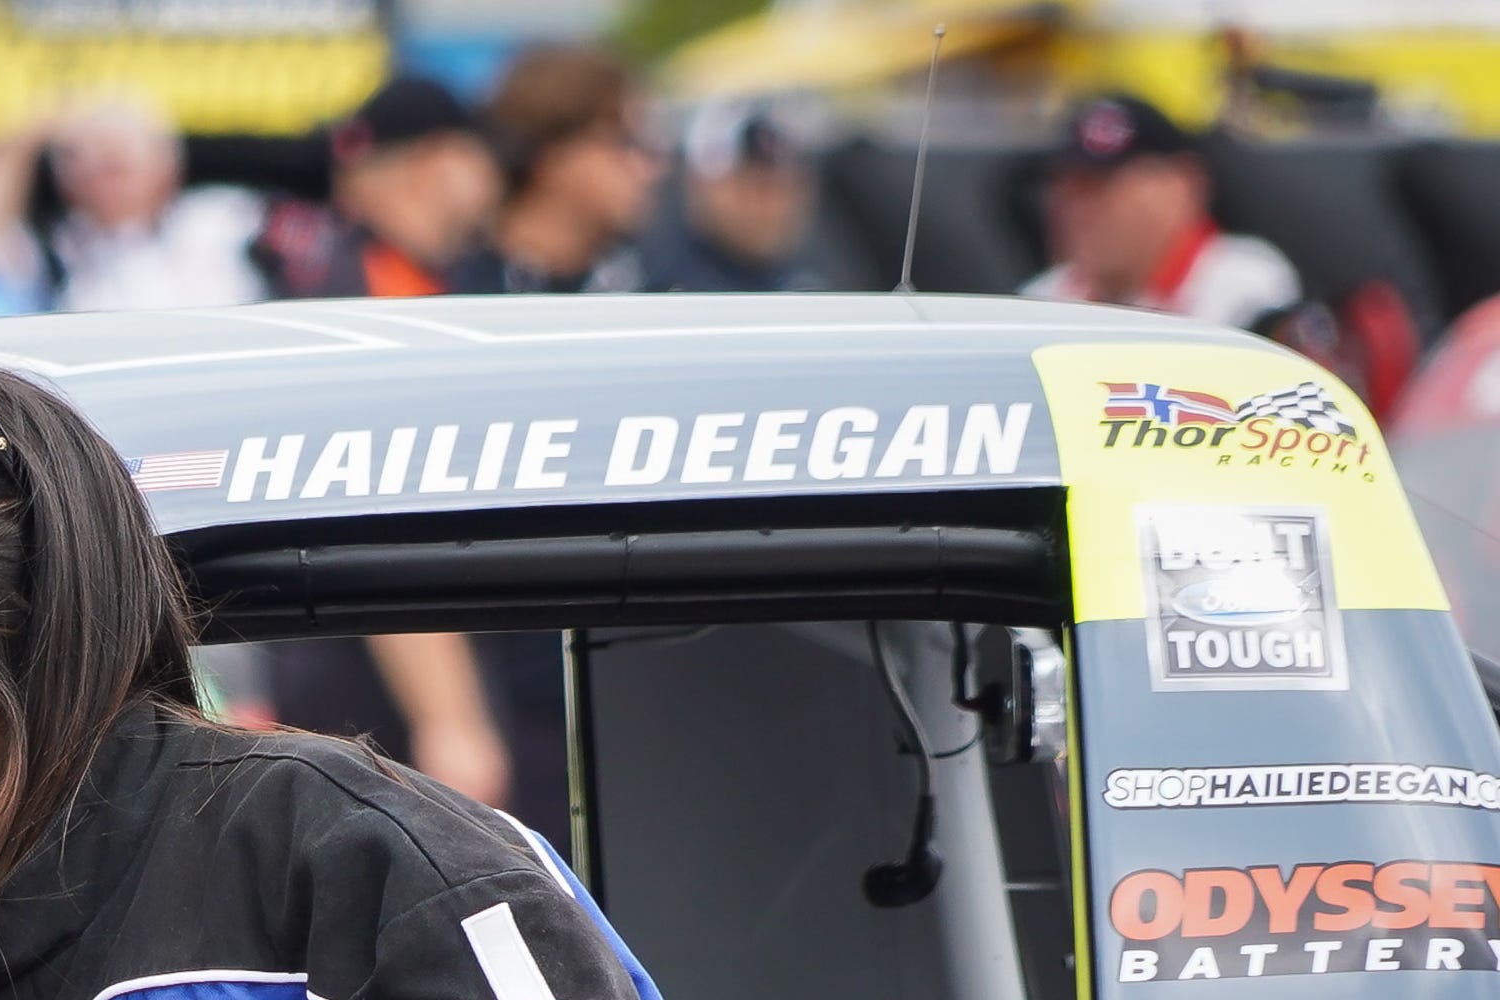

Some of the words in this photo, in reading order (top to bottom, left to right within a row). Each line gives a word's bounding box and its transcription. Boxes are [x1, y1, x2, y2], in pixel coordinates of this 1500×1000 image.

[226, 419, 579, 503] HAILIE
[604, 403, 1033, 487] DEEGAN
[1099, 419, 1371, 464] ThorSport
[1216, 454, 1375, 483] RACING
[1167, 630, 1326, 669] TOUGH
[1110, 860, 1500, 941] ODYSSE
[1118, 936, 1500, 983] BATTER
